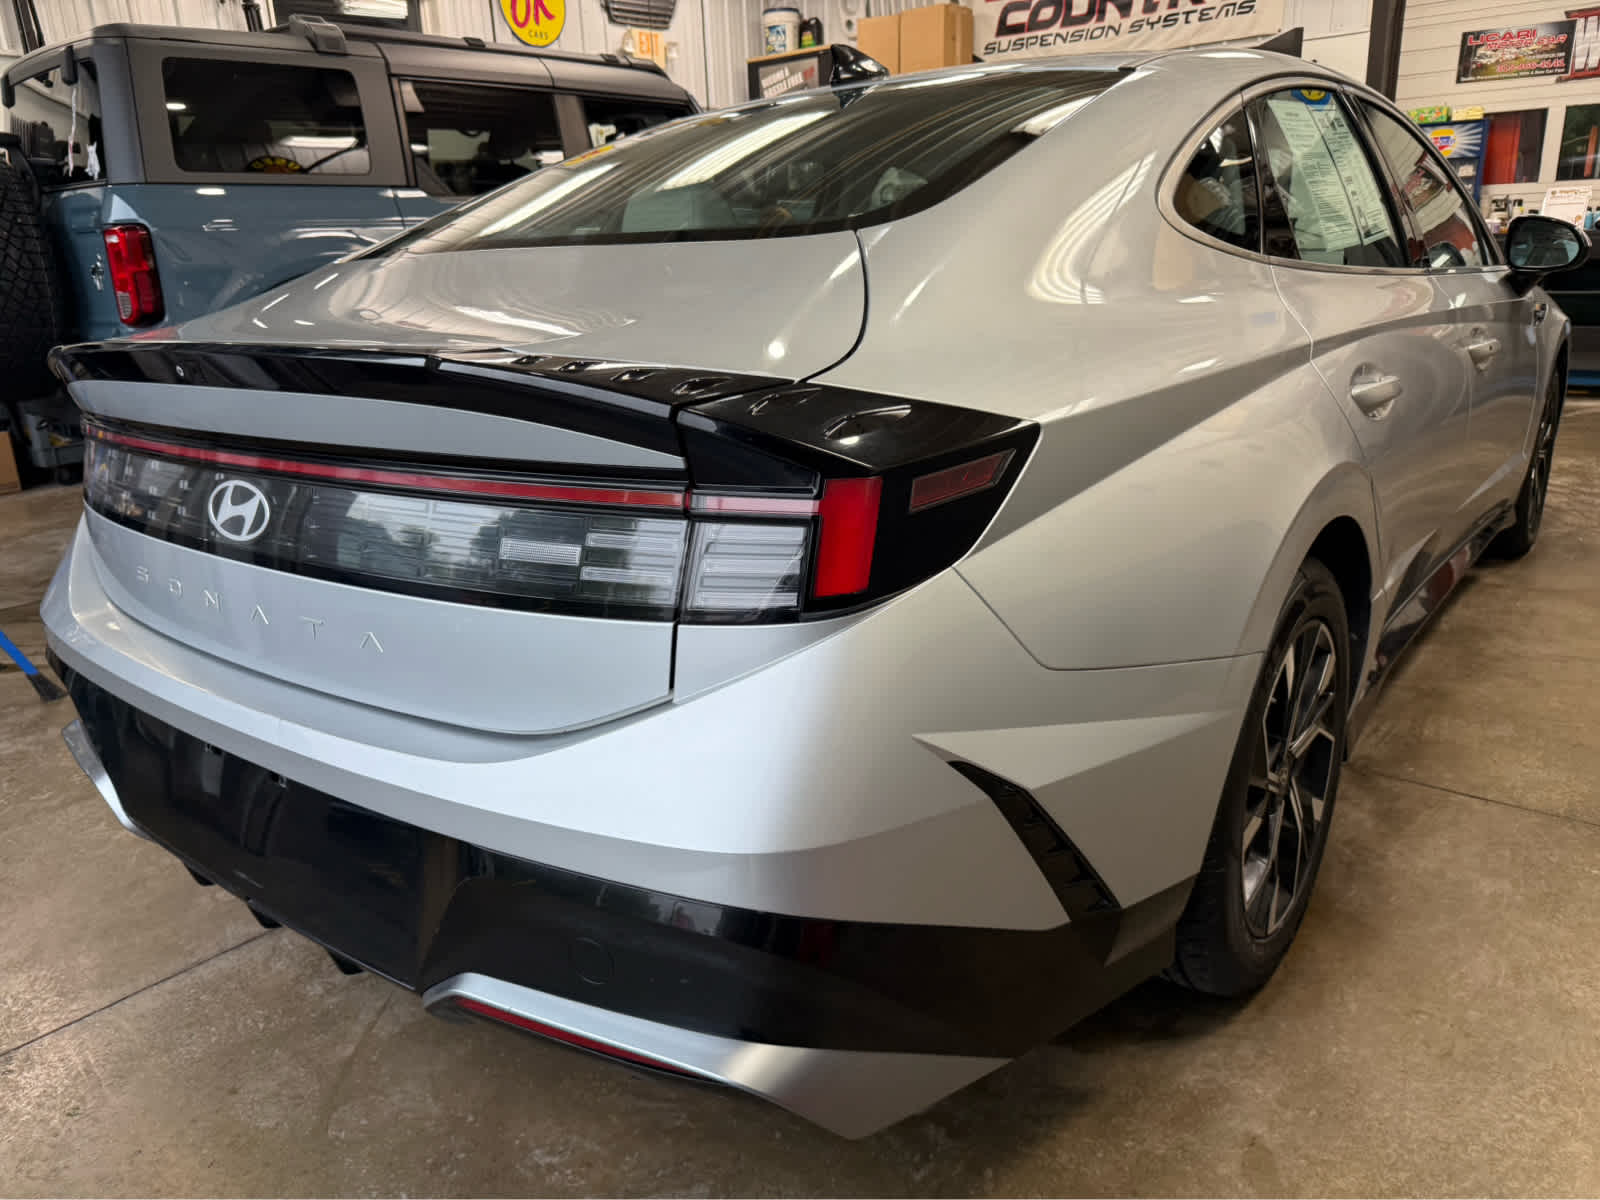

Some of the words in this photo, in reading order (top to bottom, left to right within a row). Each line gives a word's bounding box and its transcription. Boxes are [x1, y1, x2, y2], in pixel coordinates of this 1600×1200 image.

[983, 22, 1122, 56] SUSPENSION
[1128, 0, 1255, 34] SYSTEMS
[994, 0, 1206, 37] COUN
[1467, 29, 1537, 46] LICARI
[136, 564, 384, 654] SONATA
